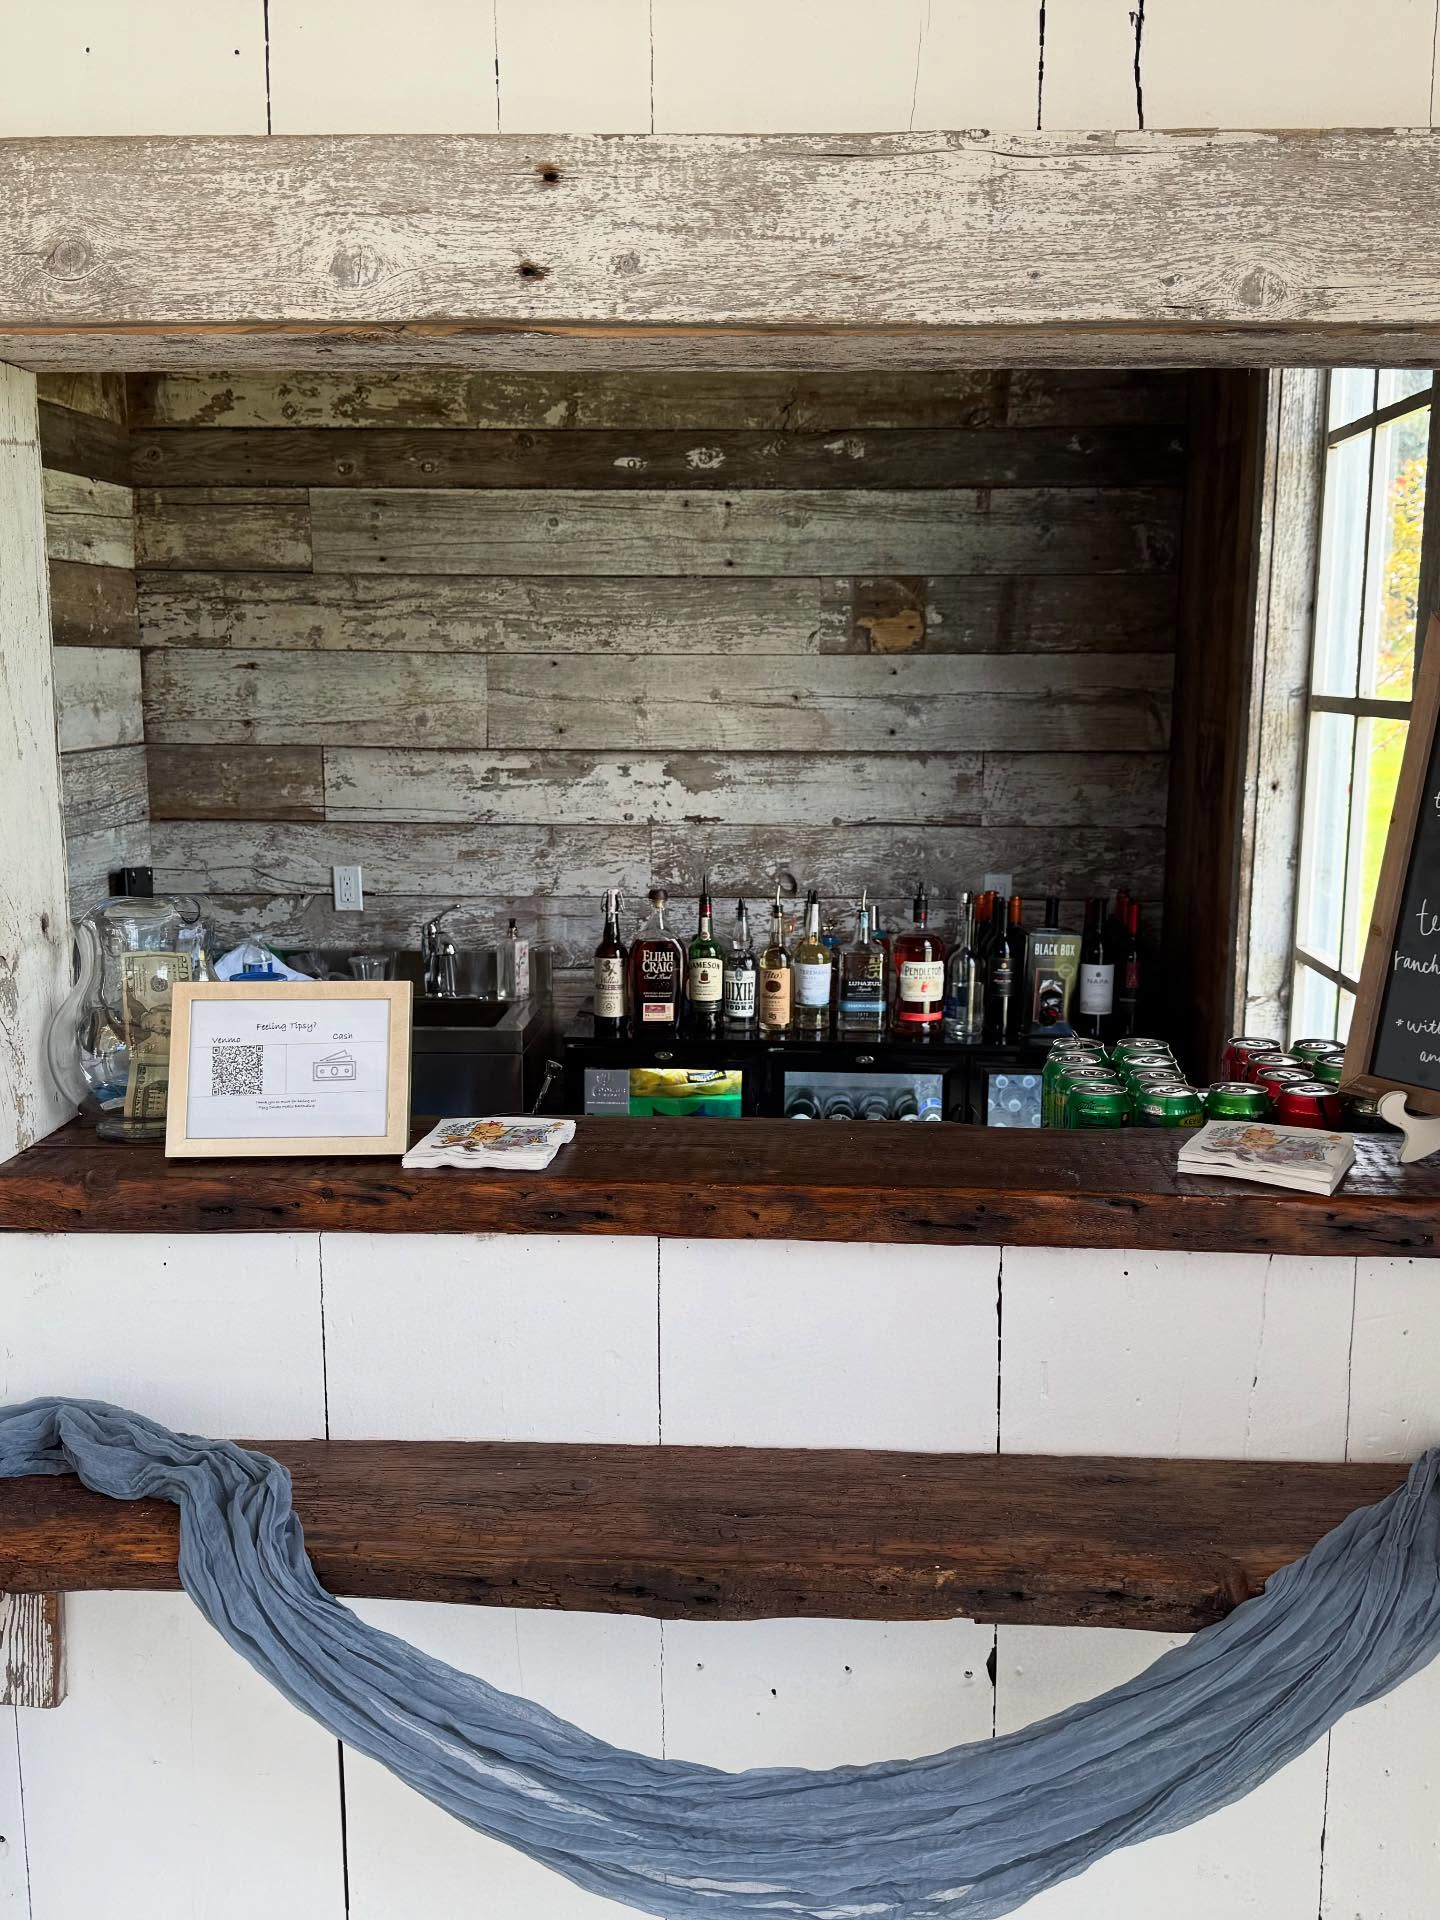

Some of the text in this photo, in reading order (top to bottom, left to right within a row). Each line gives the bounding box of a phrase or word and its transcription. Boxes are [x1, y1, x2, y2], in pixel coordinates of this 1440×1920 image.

[1034, 943, 1076, 956] BLACK BOX
[643, 950, 674, 962] ELIJAH
[642, 961, 673, 973] CRAIG
[689, 961, 720, 969] JAMESON
[764, 970, 783, 979] Tito's
[848, 980, 882, 988] LUNAZUL
[1087, 977, 1109, 985] NAPA
[725, 981, 754, 1001] DIXIE
[256, 1021, 318, 1032] Feeling Tipsy?
